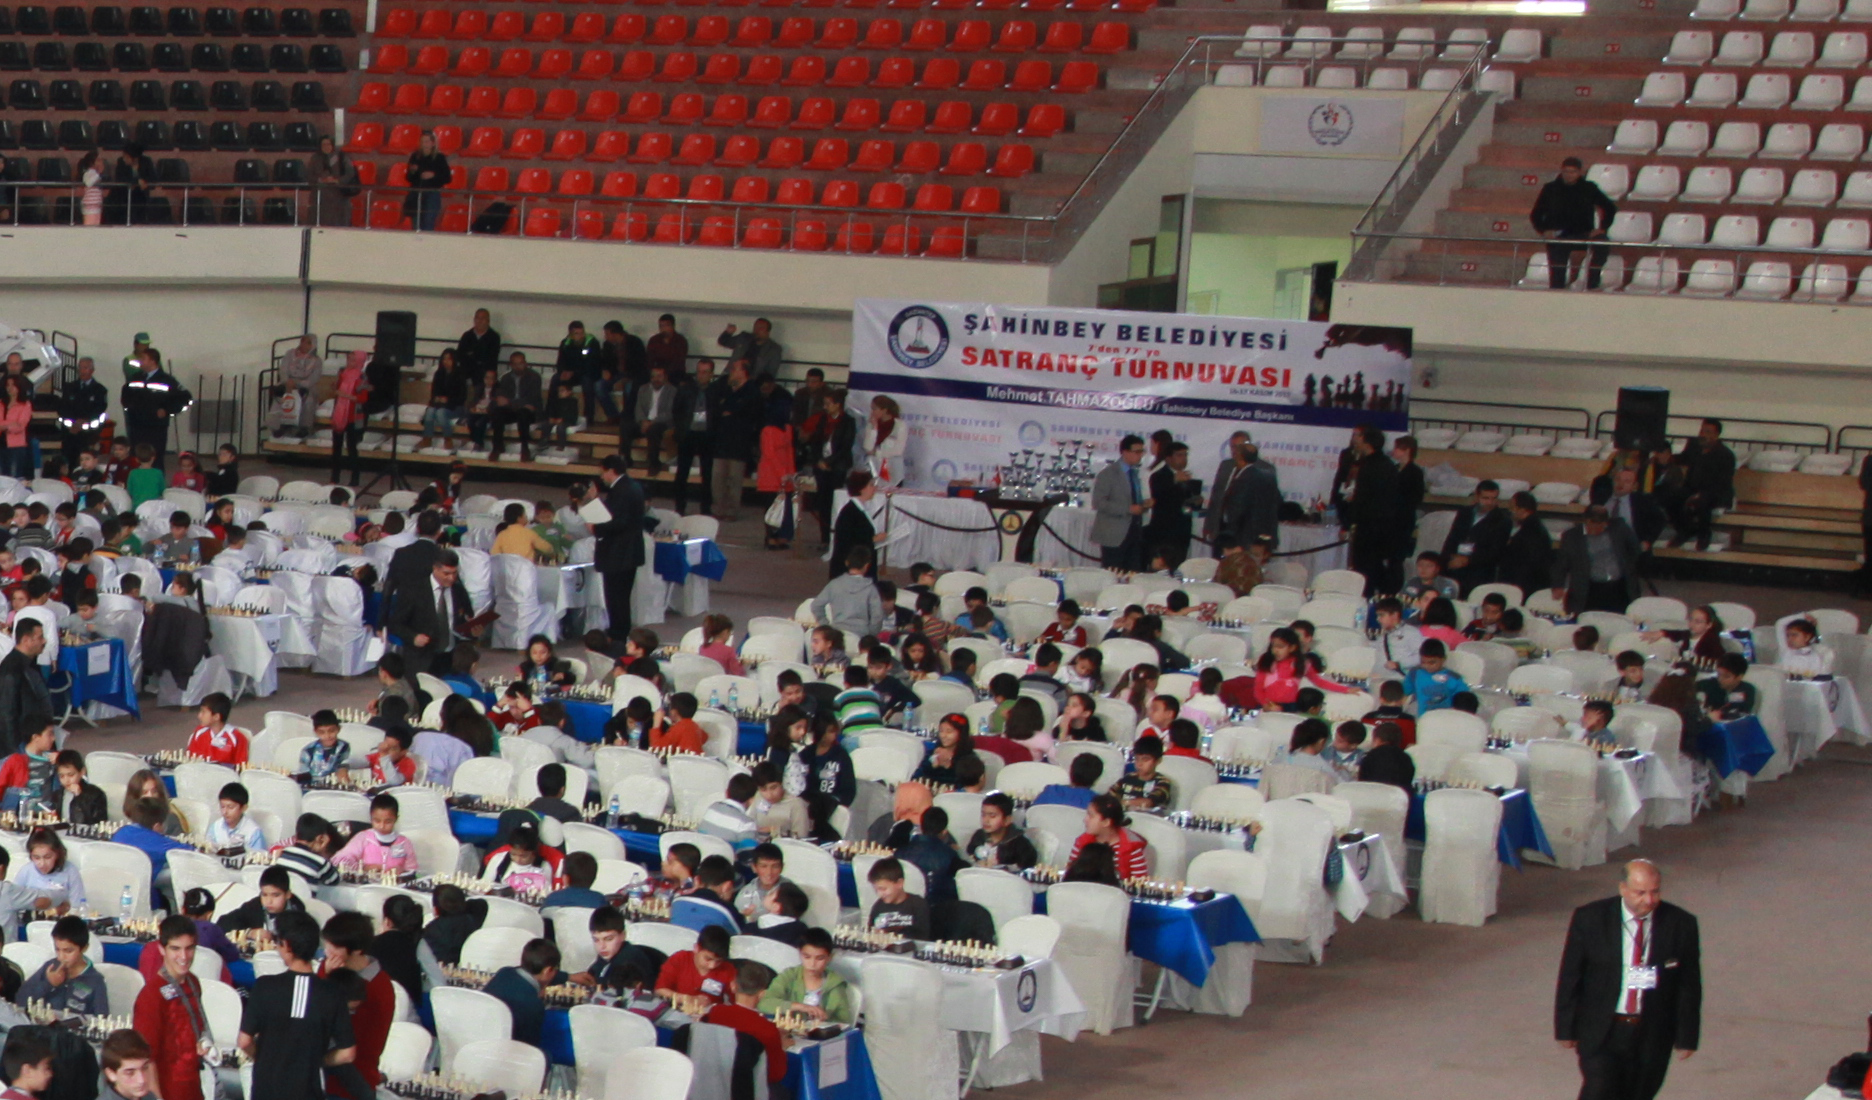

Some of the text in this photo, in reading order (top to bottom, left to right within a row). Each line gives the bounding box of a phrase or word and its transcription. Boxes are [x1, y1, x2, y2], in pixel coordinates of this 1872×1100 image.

[964, 313, 1288, 352] ŞAHİNBEY BELEDİYESİ
[961, 345, 1292, 389] SATRANÇ TURNUVASI
[986, 386, 1045, 403] Mehmet
